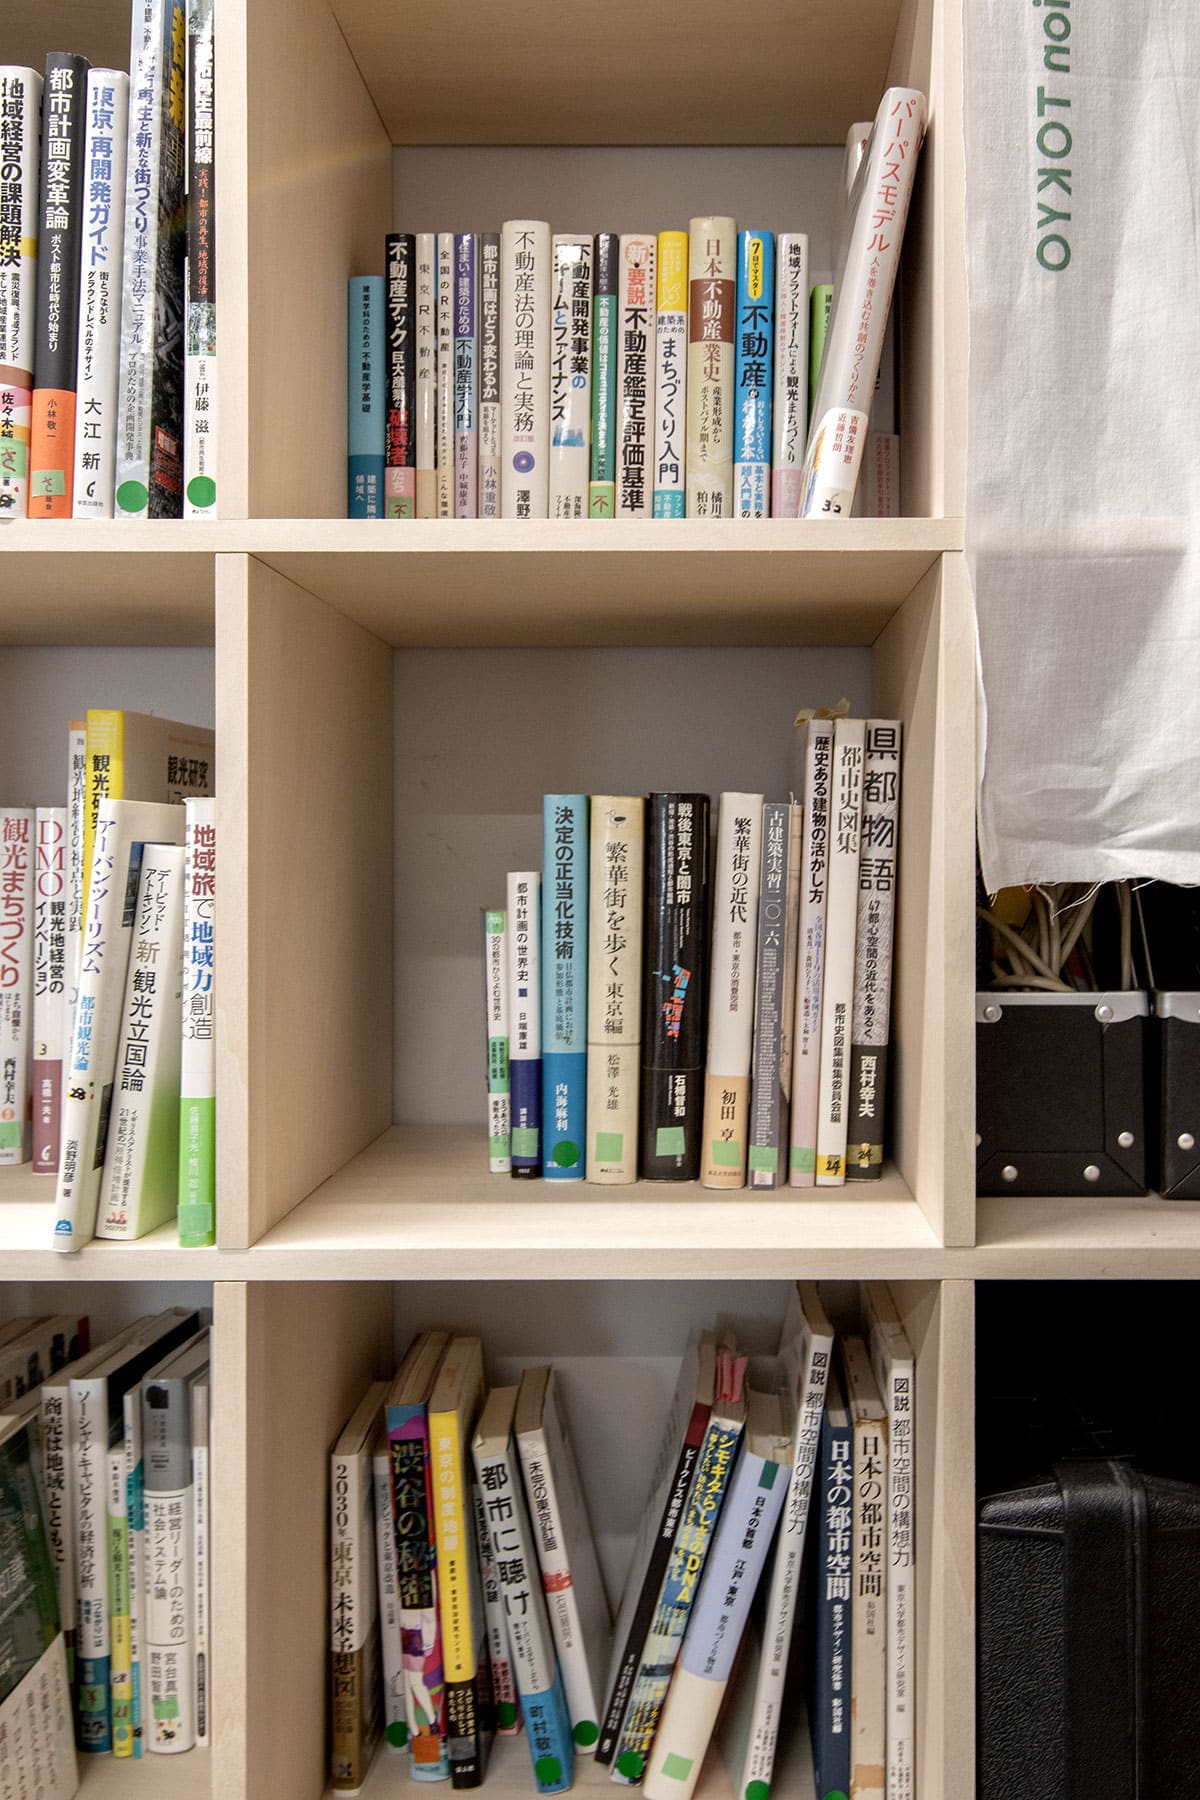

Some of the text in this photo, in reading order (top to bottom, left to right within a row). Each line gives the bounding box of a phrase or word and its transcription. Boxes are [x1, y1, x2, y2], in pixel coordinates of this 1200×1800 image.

[0, 77, 25, 268] 地域経営の課題解決
[45, 67, 75, 231] 都市計画変革論
[88, 85, 115, 267] 東京・再開発ガイド
[866, 98, 917, 254] パーパスモデル
[48, 235, 62, 353] ポスト都市化時代の始まり
[84, 271, 95, 381] グラウンドレベルのデザイン
[99, 271, 110, 325] 街とつながる
[130, 234, 149, 345] 事業手法マニュアル
[388, 241, 408, 347] 不動産テック
[418, 263, 430, 380] 東京R不動産
[439, 250, 450, 352] 全国のR不動産
[458, 241, 471, 334] 住まい・建築のための
[482, 244, 498, 400] 都市計画はどう変わるか
[702, 239, 723, 383] 日本不動産業史
[750, 241, 762, 297] 7日でマスター
[361, 352, 371, 413] 不動産学基礎
[457, 339, 472, 429] 不動産学入門
[513, 231, 535, 433] 不動産法の理論と実務
[786, 243, 802, 464] 地域プラットフォームによる観光まちづくり
[846, 256, 881, 405] 人を巻き込む共創のつくりかた
[46, 398, 58, 438] 小林敬一
[621, 307, 648, 513] 不動産鑑定評価基準
[658, 337, 681, 484] まちづくり入門
[711, 385, 723, 444] 産業形成から
[515, 489, 531, 519] 澤野
[710, 490, 723, 519] 橘川
[167, 755, 209, 790] 観光研究
[808, 736, 831, 905] 歴史ある建物の活かし方
[835, 745, 862, 855] 都市史図集
[858, 727, 899, 892] 県都物語
[1, 817, 29, 989] 観光まちづくり
[36, 820, 66, 897] DMO
[83, 819, 117, 975] アーバンツーリズム
[139, 867, 157, 936] アトキンソン
[554, 806, 575, 960] 決定の正当化技術
[676, 802, 694, 905] 戦後東京と闇市
[729, 816, 752, 924] 繁華街の近代
[763, 810, 786, 946] 古建築実習二〇一六
[34, 901, 50, 997] イノベーション
[49, 900, 66, 994] 観光地経営の
[189, 823, 216, 1041] 地域旅で地域力創造
[516, 882, 529, 982] 都市計画の世界史
[862, 899, 882, 1040] 47都心空間の近代をあるく
[73, 995, 96, 1072] 都市観光論
[120, 939, 161, 1093] 新・観光立国論
[555, 1082, 569, 1132] 内海麻利
[857, 1055, 878, 1118] 西村幸夫
[808, 1351, 828, 1386] 図説
[76, 1390, 97, 1590] ソーシャル・キャピタルの経済分析
[676, 1433, 736, 1604] シモキタらしさのDNA
[786, 1391, 824, 1536] 都市空間の構想力
[825, 1440, 853, 1601] 日本の都市空間
[858, 1436, 883, 1598] 日本の都市空間
[891, 1377, 912, 1569] 図説 都市空間の構想力
[152, 1502, 168, 1601] 社会システム論
[168, 1500, 185, 1639] 経営リーダーのための
[481, 1462, 531, 1617] 都市に聴け
